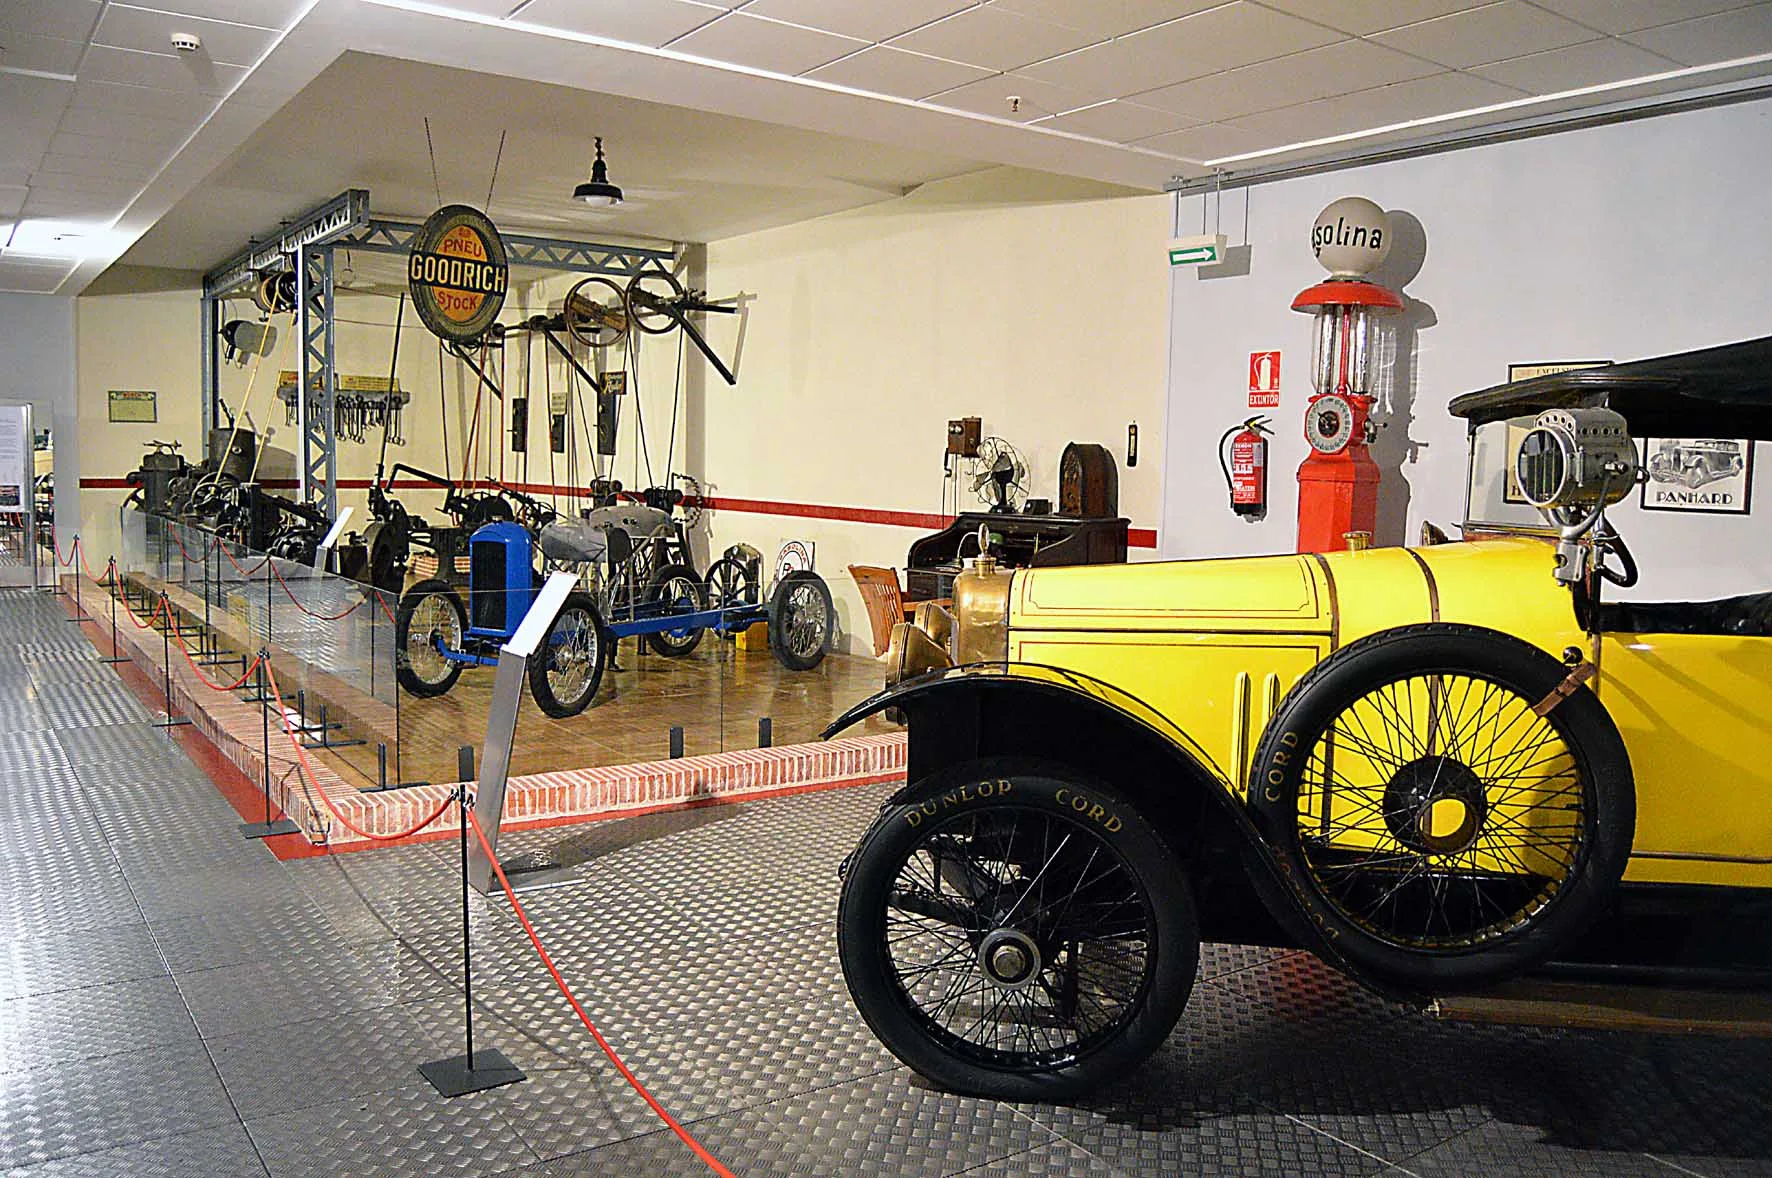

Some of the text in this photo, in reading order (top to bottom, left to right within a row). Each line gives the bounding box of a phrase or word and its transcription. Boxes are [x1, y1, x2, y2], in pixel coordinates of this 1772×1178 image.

[1312, 217, 1383, 249] solina
[443, 239, 482, 257] PNEU
[411, 254, 506, 294] GOODRICH
[438, 291, 477, 310] STOCK
[1249, 394, 1279, 405] EXTINTOR
[1656, 491, 1733, 505] PANHARD
[1265, 730, 1298, 802] CORD
[903, 779, 1123, 833] DUNLOP CORD
